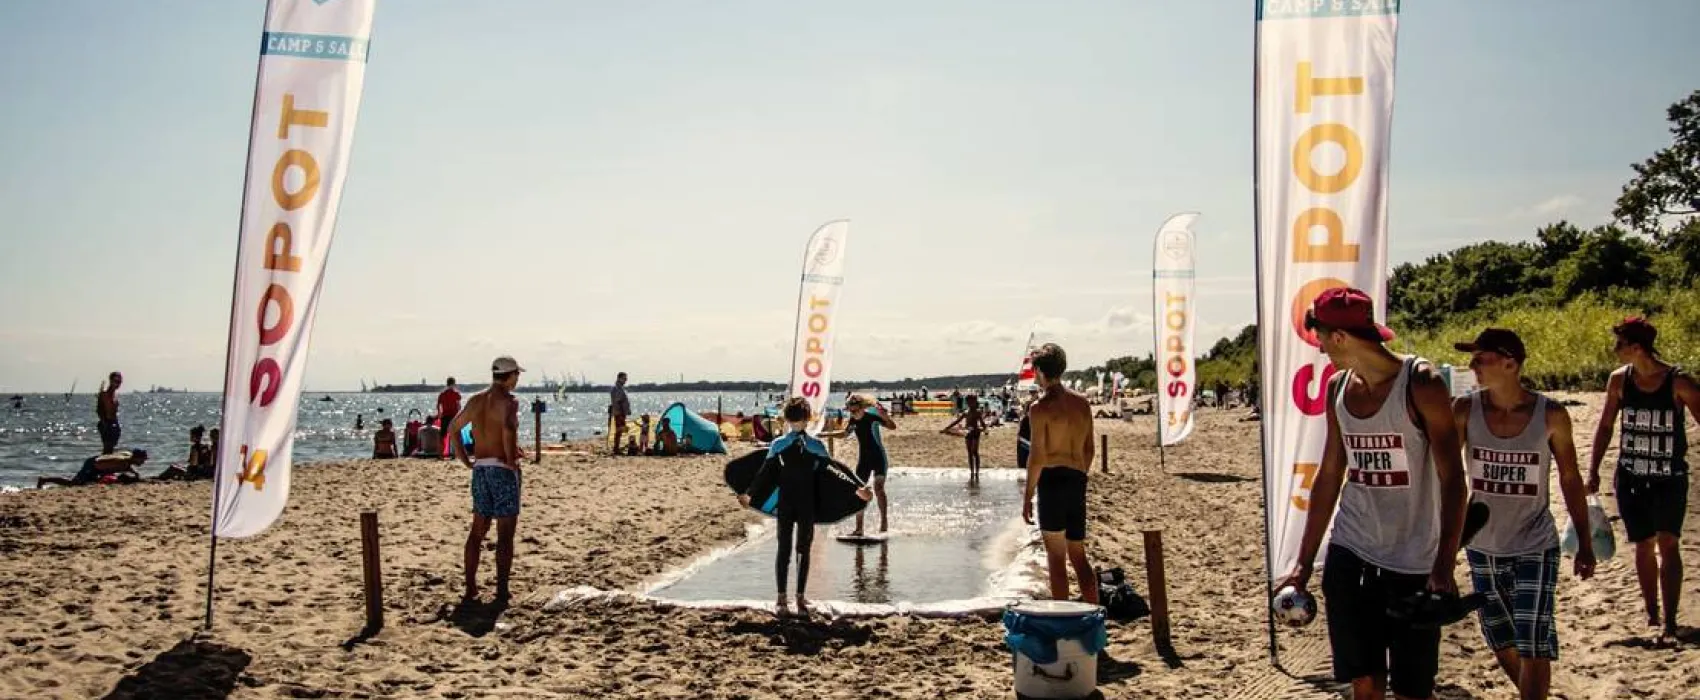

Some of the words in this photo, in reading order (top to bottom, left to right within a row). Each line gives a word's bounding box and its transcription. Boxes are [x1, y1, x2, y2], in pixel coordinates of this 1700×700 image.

[267, 36, 312, 53] CAMP
[250, 92, 329, 408] SOPOT
[801, 294, 832, 398] SOPOT
[1166, 291, 1188, 398] SOPOT
[1622, 407, 1673, 433] CALI
[1621, 432, 1673, 458] CALI
[1353, 451, 1392, 471] UPER
[1483, 463, 1526, 482] SUPER
